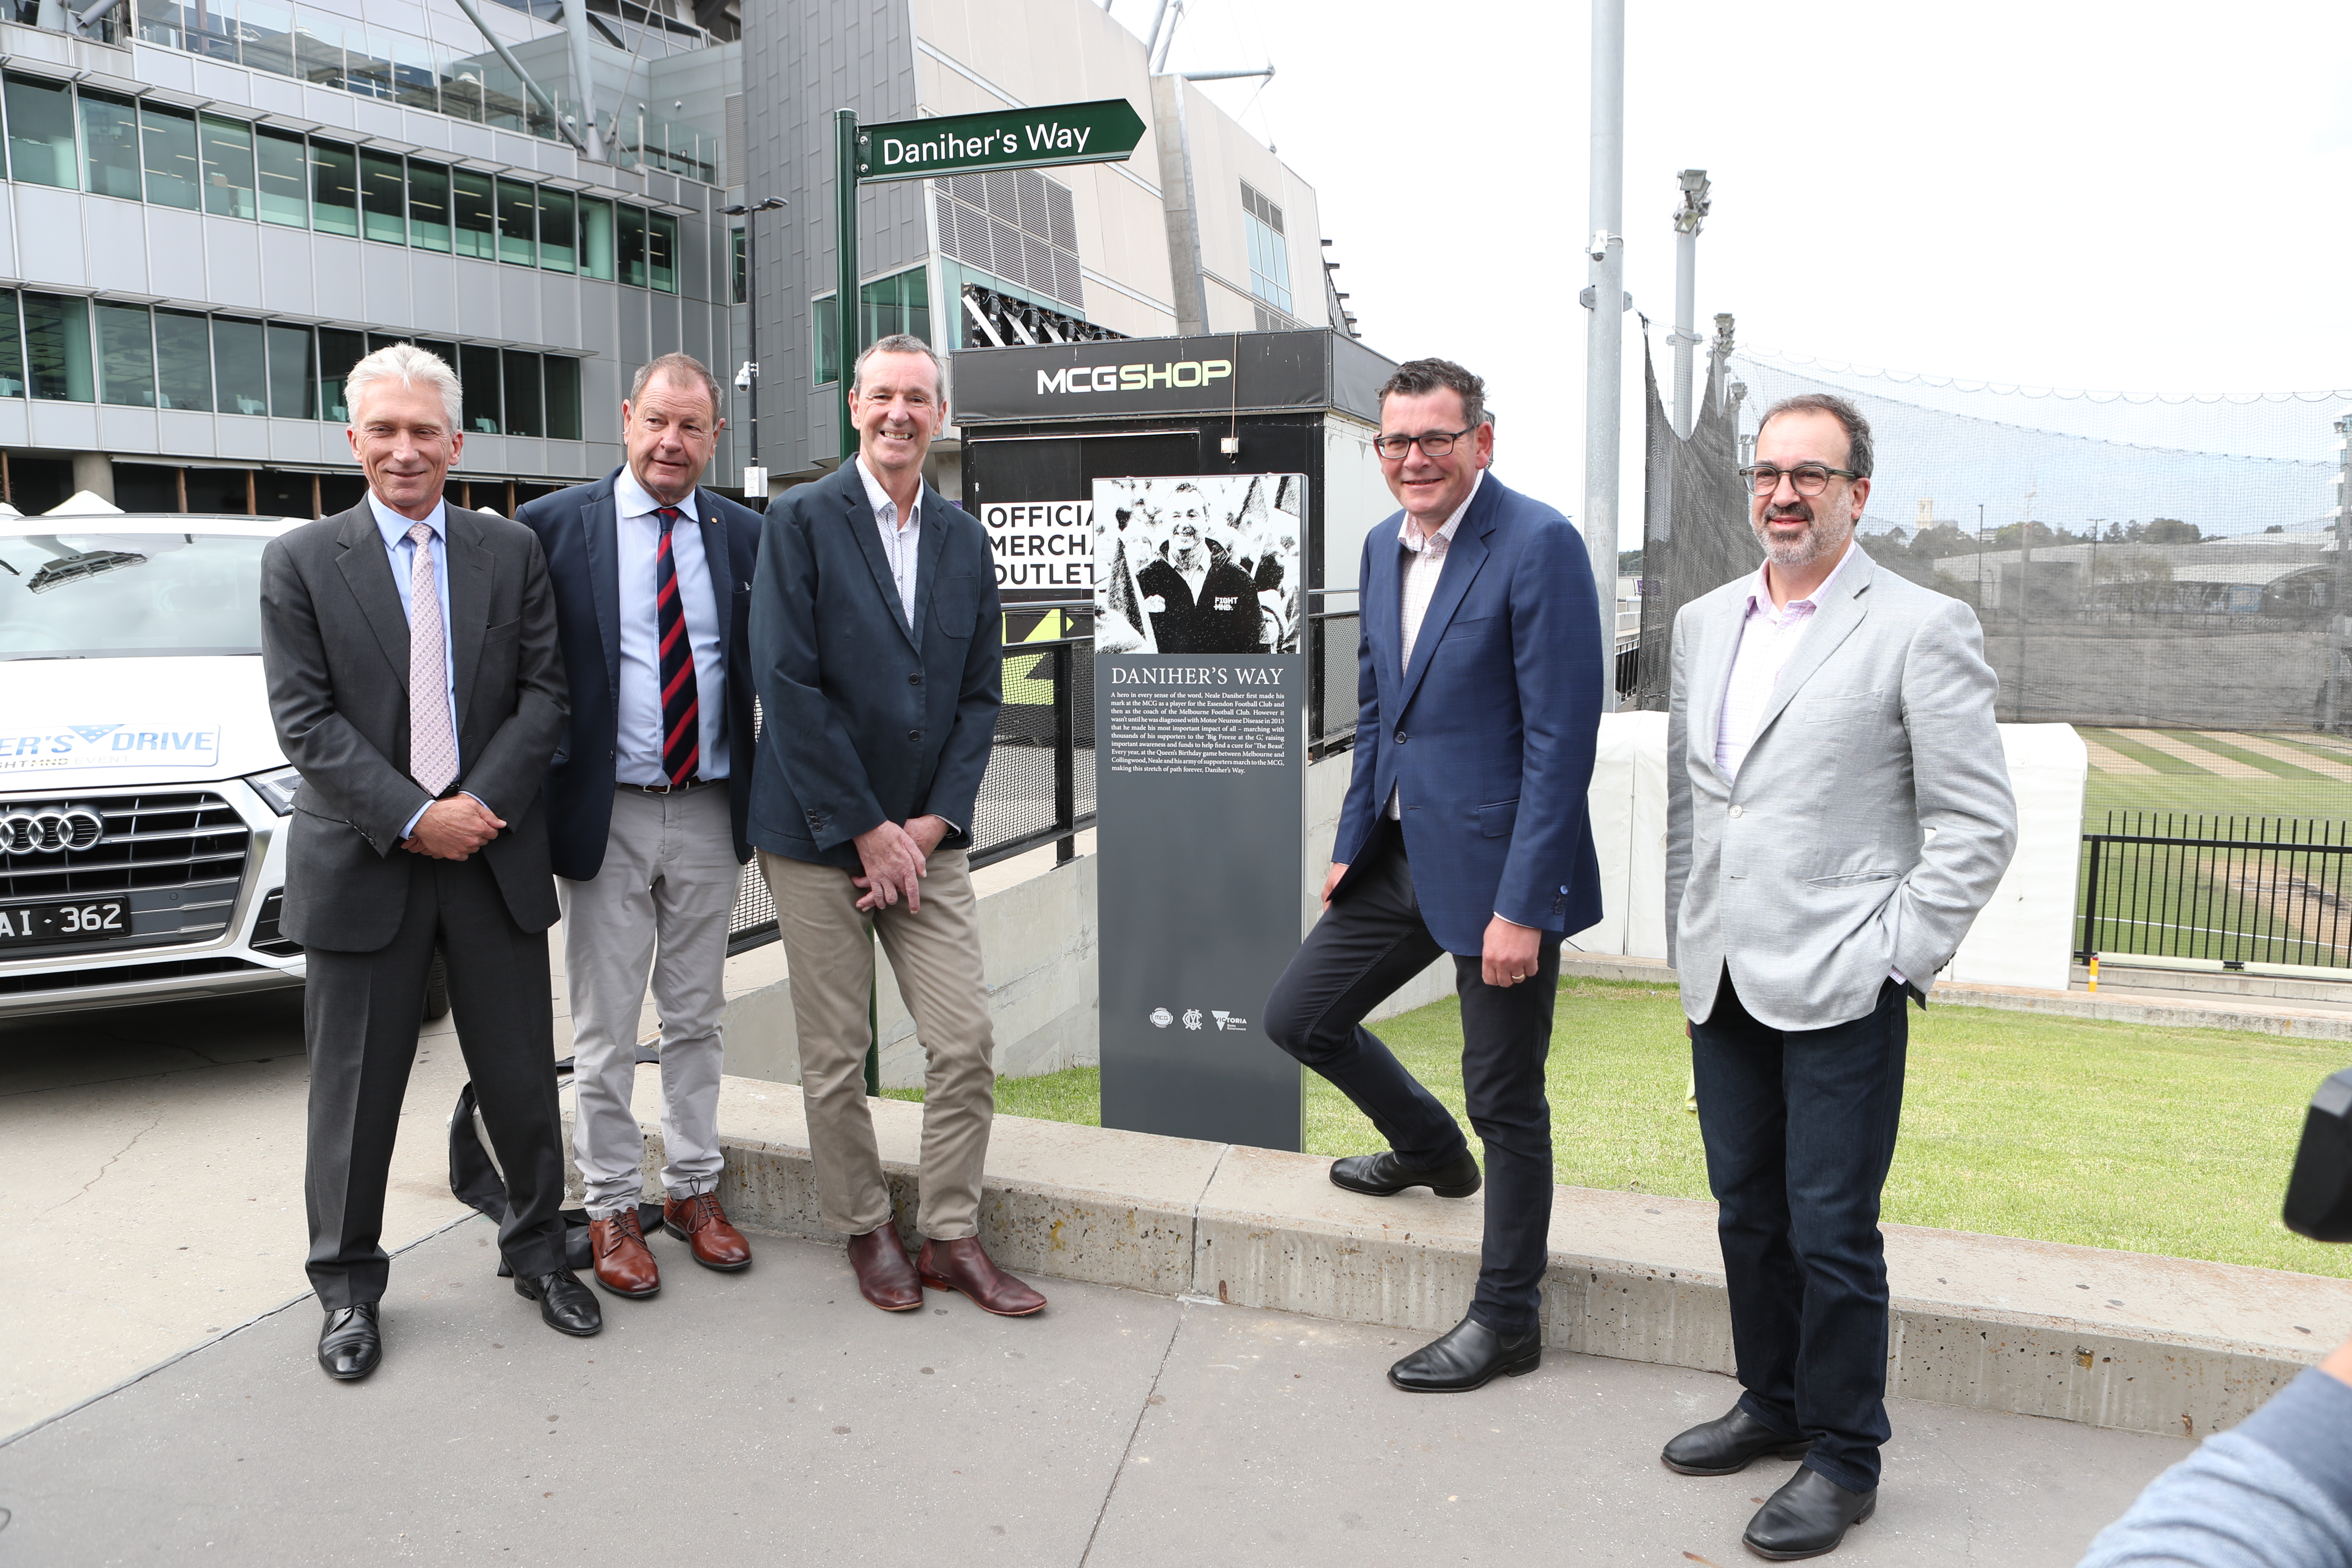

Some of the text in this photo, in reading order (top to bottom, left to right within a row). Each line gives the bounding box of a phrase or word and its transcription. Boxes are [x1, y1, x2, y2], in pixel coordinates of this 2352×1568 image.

[883, 122, 1091, 165] Daniher's Way
[989, 534, 1093, 556] MERCH
[1111, 667, 1284, 685] DANIHER’S WAY
[1170, 700, 1187, 708] player
[1159, 716, 1187, 724] diagnosed
[111, 732, 214, 750] DRIVE
[1111, 741, 1138, 749] important
[1201, 741, 1214, 750] help
[1178, 749, 1202, 758] Birthday
[74, 755, 131, 765] EVENT
[1111, 756, 1148, 765] Collingwood,
[1112, 765, 1132, 773] making
[1170, 766, 1182, 774] path
[59, 903, 122, 932] 362
